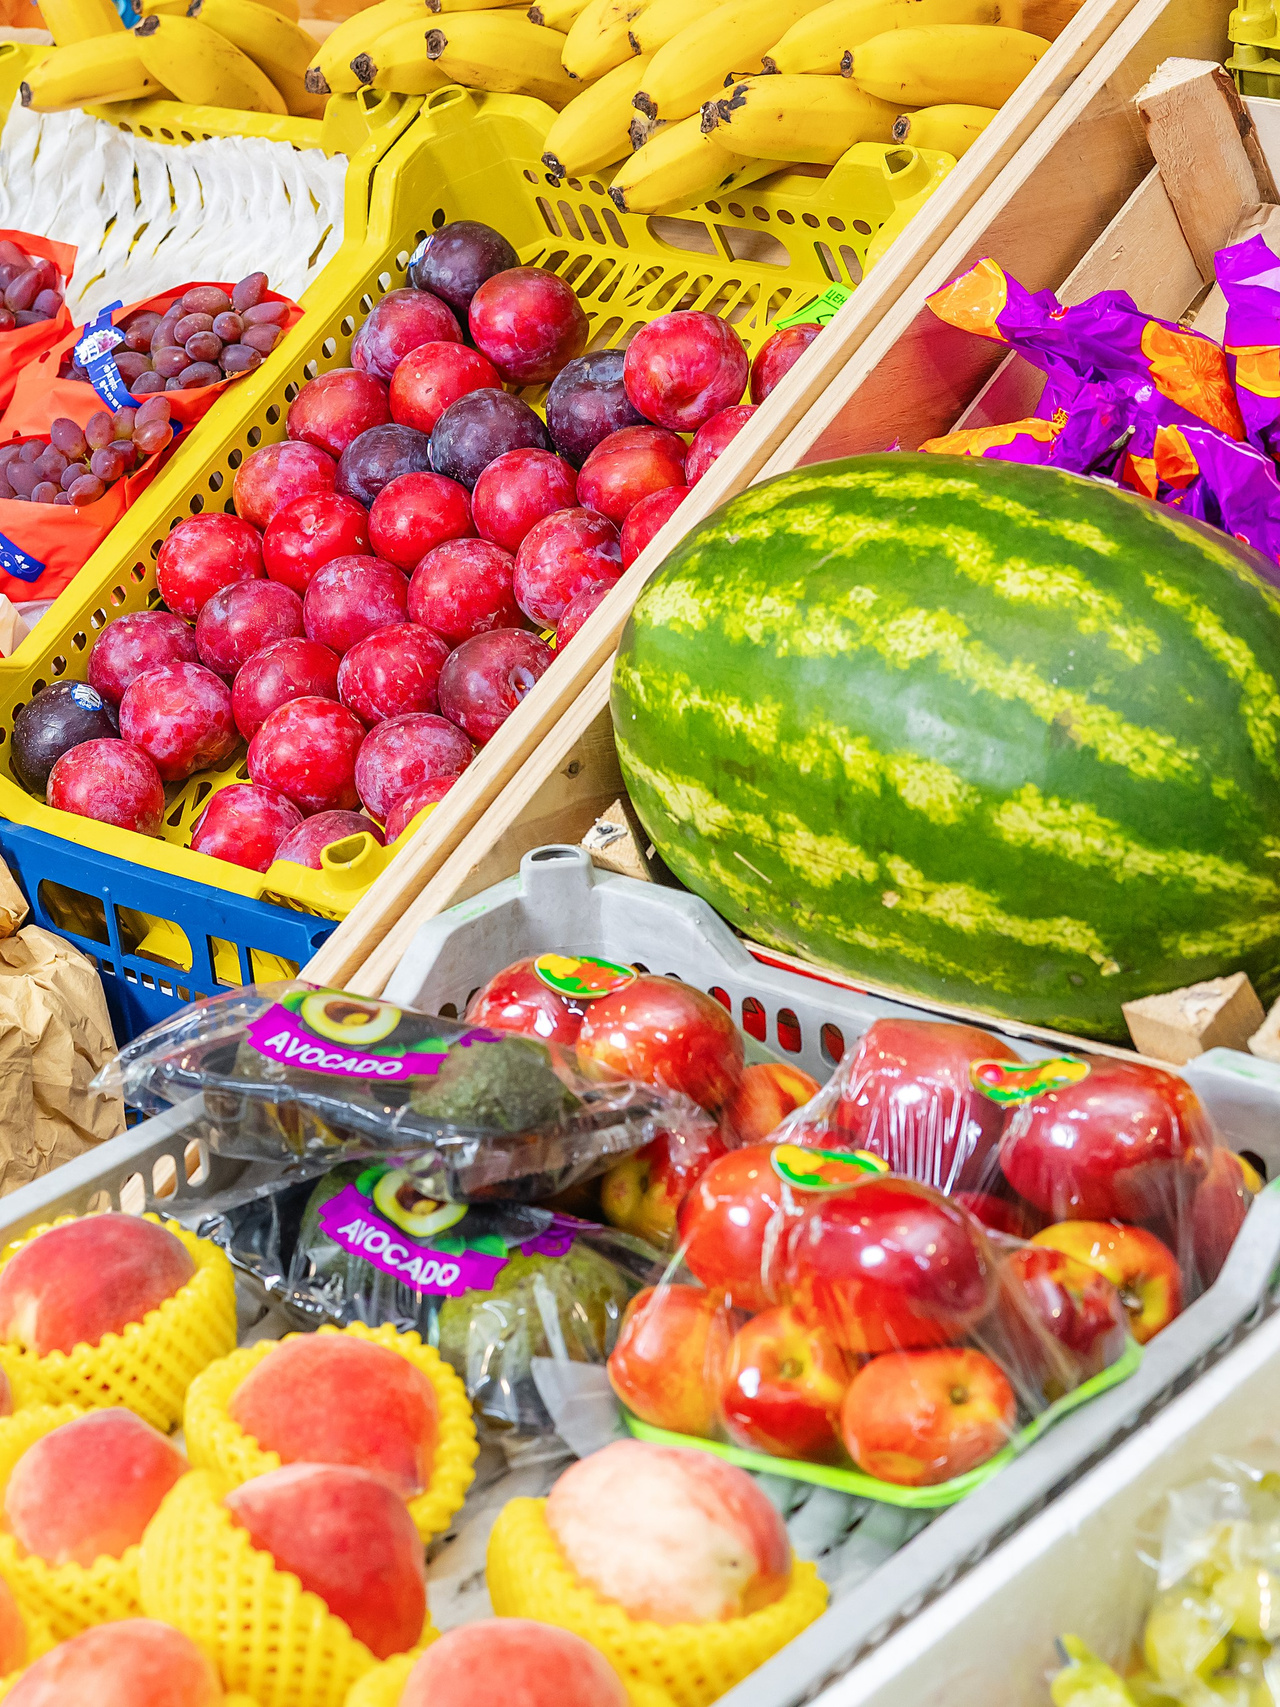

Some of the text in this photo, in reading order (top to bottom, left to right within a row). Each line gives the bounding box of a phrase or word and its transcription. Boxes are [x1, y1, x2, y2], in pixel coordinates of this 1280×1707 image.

[825, 289, 848, 306] ЦЕН
[264, 1031, 403, 1076] AVOCADO
[337, 1218, 461, 1287] AVOCADO
